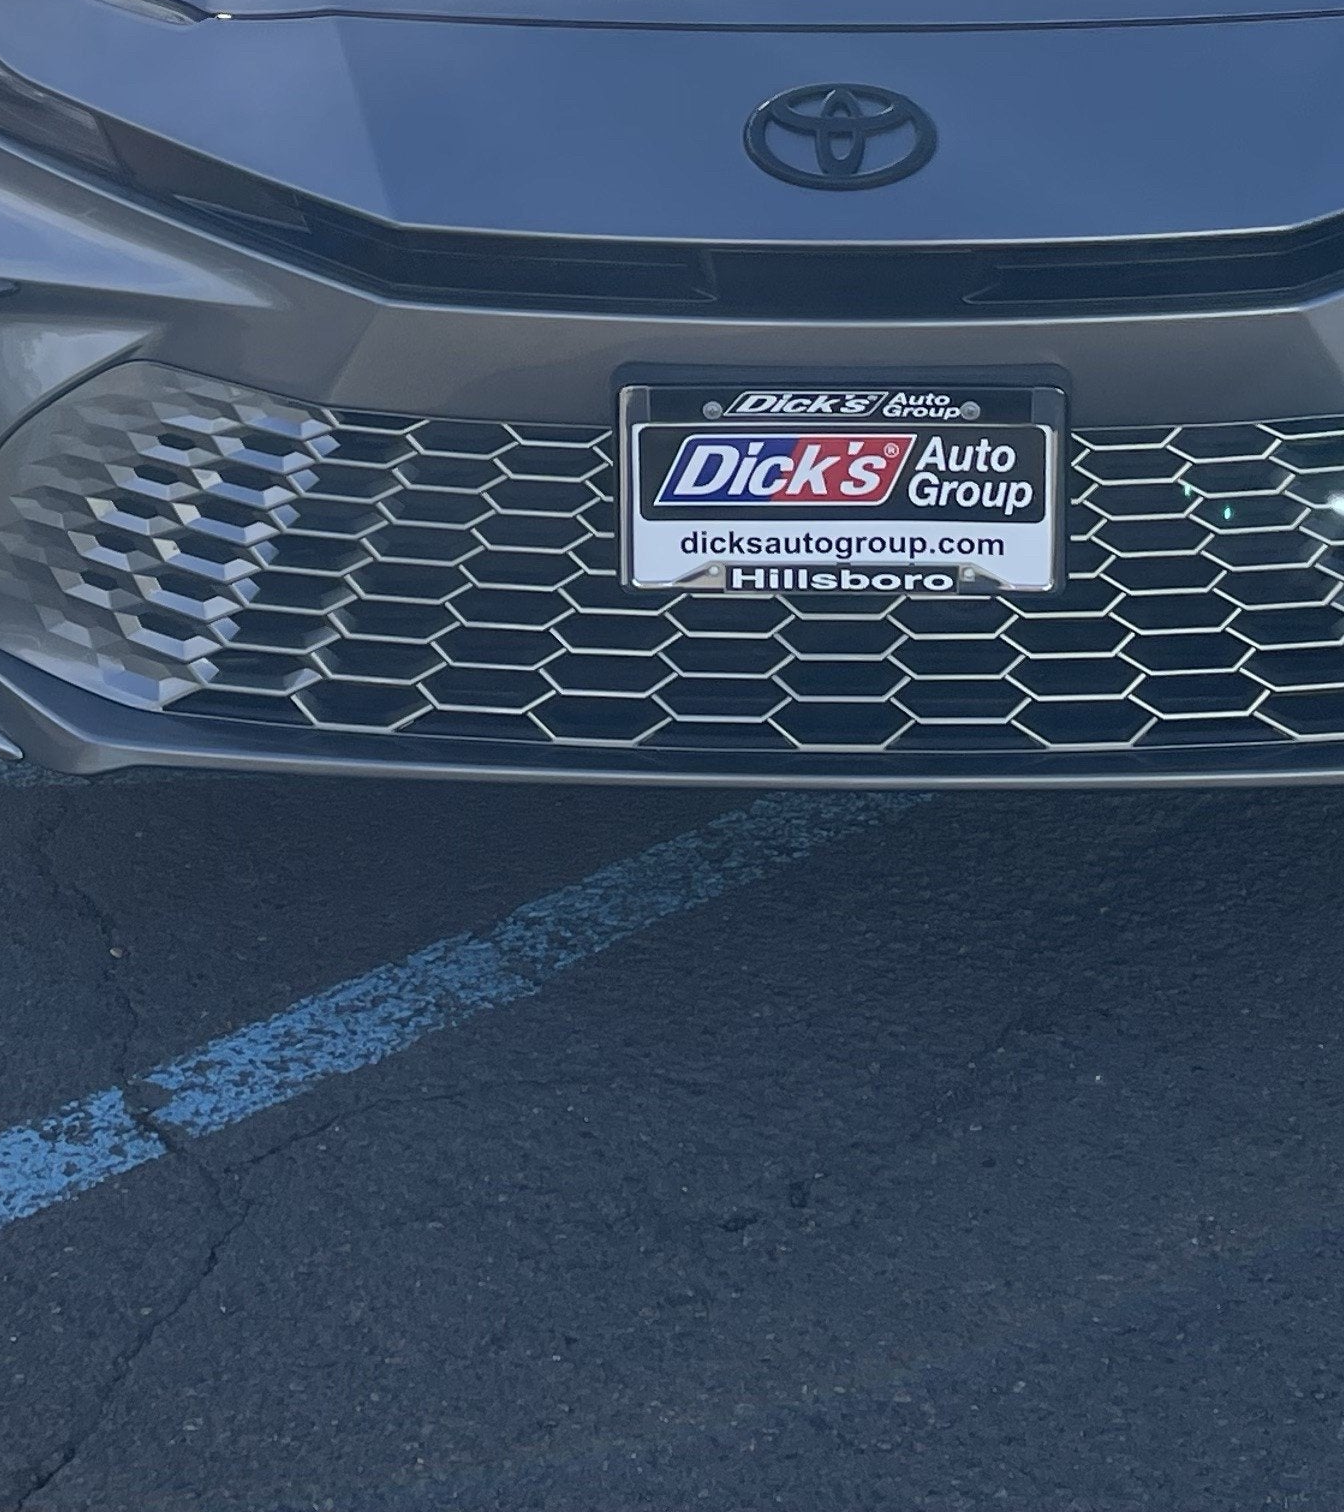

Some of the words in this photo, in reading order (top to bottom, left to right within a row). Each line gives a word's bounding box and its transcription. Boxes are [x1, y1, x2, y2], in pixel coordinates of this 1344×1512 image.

[736, 394, 871, 414] Dick's
[889, 392, 951, 406] Auto
[882, 405, 961, 420] Group
[915, 436, 1016, 473] Auto
[672, 441, 887, 496] Dick's
[908, 472, 1033, 516] Group
[680, 530, 1006, 559] dicksautogroup.com
[731, 567, 955, 591] Hillsboro
